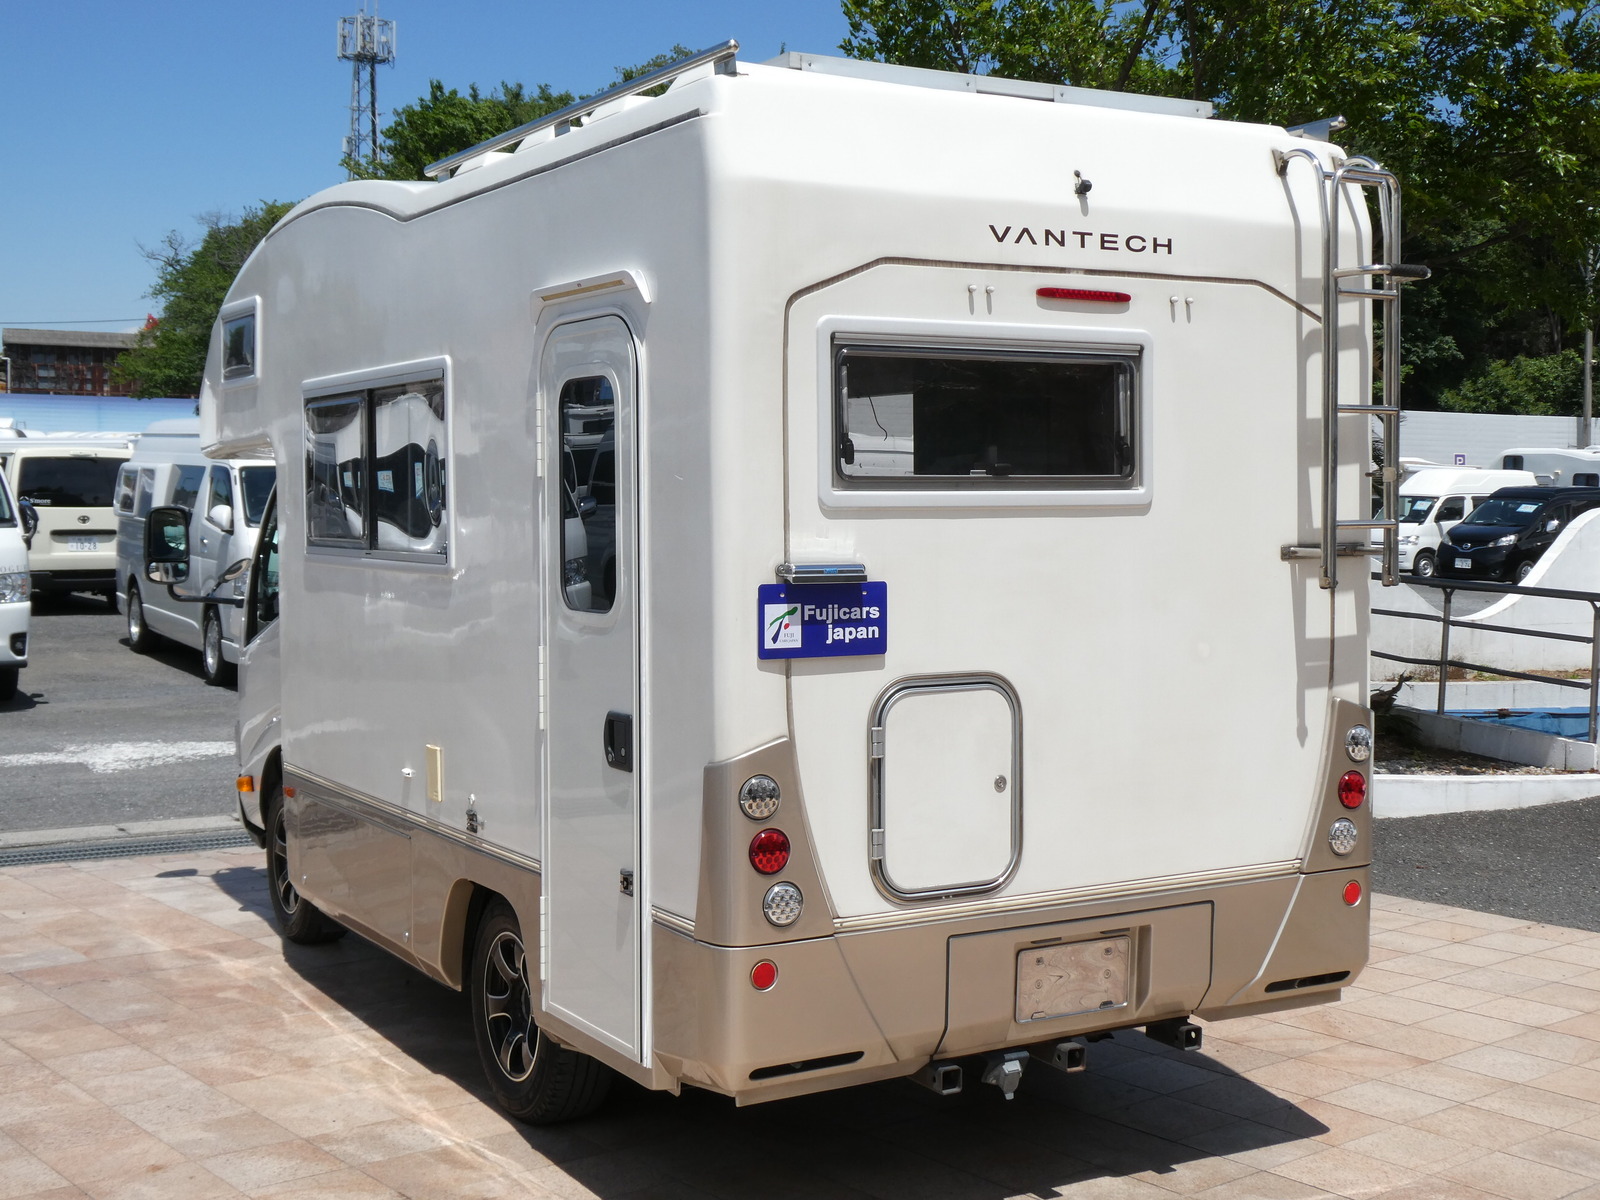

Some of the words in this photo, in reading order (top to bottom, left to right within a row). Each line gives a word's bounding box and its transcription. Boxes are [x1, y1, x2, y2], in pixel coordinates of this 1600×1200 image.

[988, 224, 1173, 255] VANTECH
[803, 604, 880, 624] Fujicars
[825, 624, 879, 644] japan
